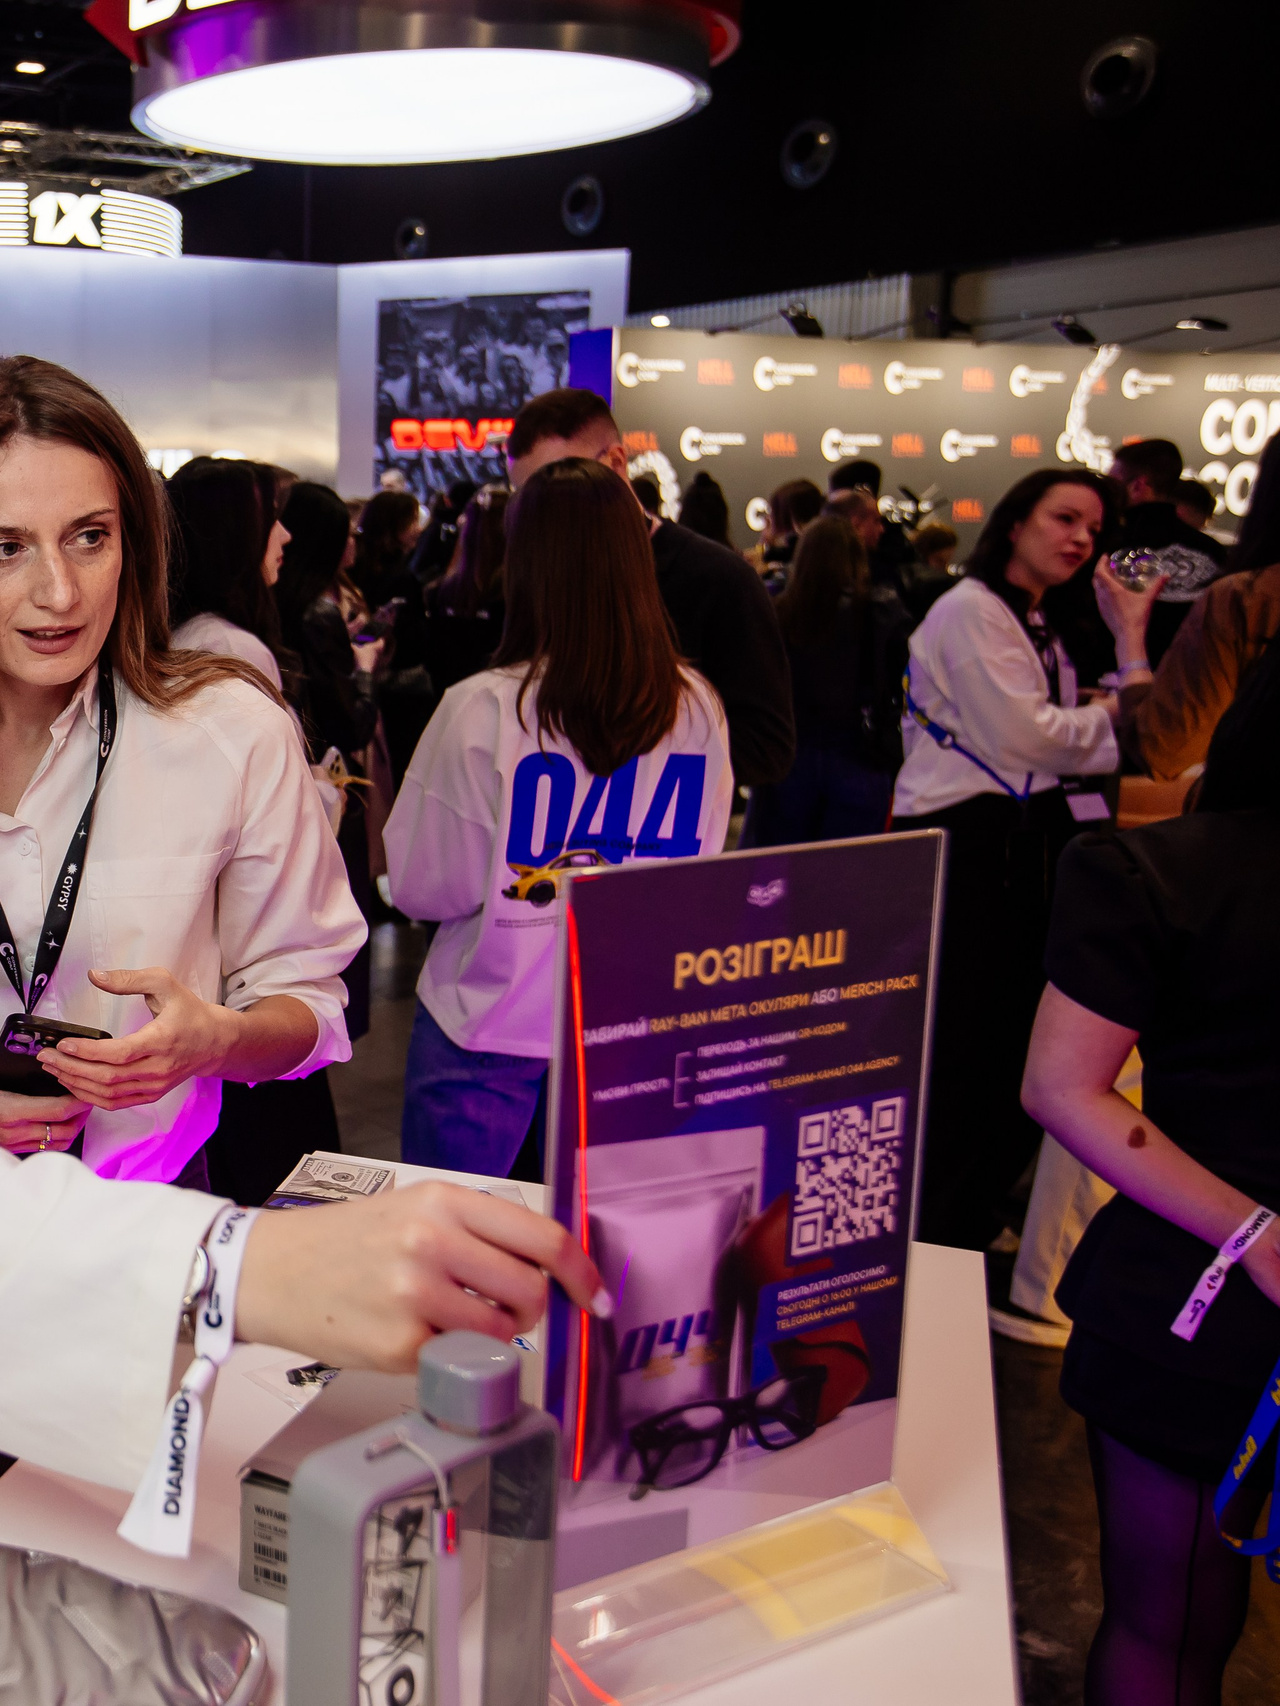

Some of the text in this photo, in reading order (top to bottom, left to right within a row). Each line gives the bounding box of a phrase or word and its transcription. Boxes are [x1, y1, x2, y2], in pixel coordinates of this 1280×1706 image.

[29, 191, 104, 247] 1X
[391, 418, 516, 452] DEV
[506, 751, 707, 868] 044
[57, 876, 73, 911] GYPSY
[673, 928, 848, 990] РОЗІГРАШ
[649, 1011, 709, 1034] RAY-BAN
[839, 980, 885, 1001] MERCH
[886, 974, 919, 993] PACK
[830, 1264, 887, 1287] ОГОЛОСИМО
[254, 1504, 288, 1523] WAYFARE
